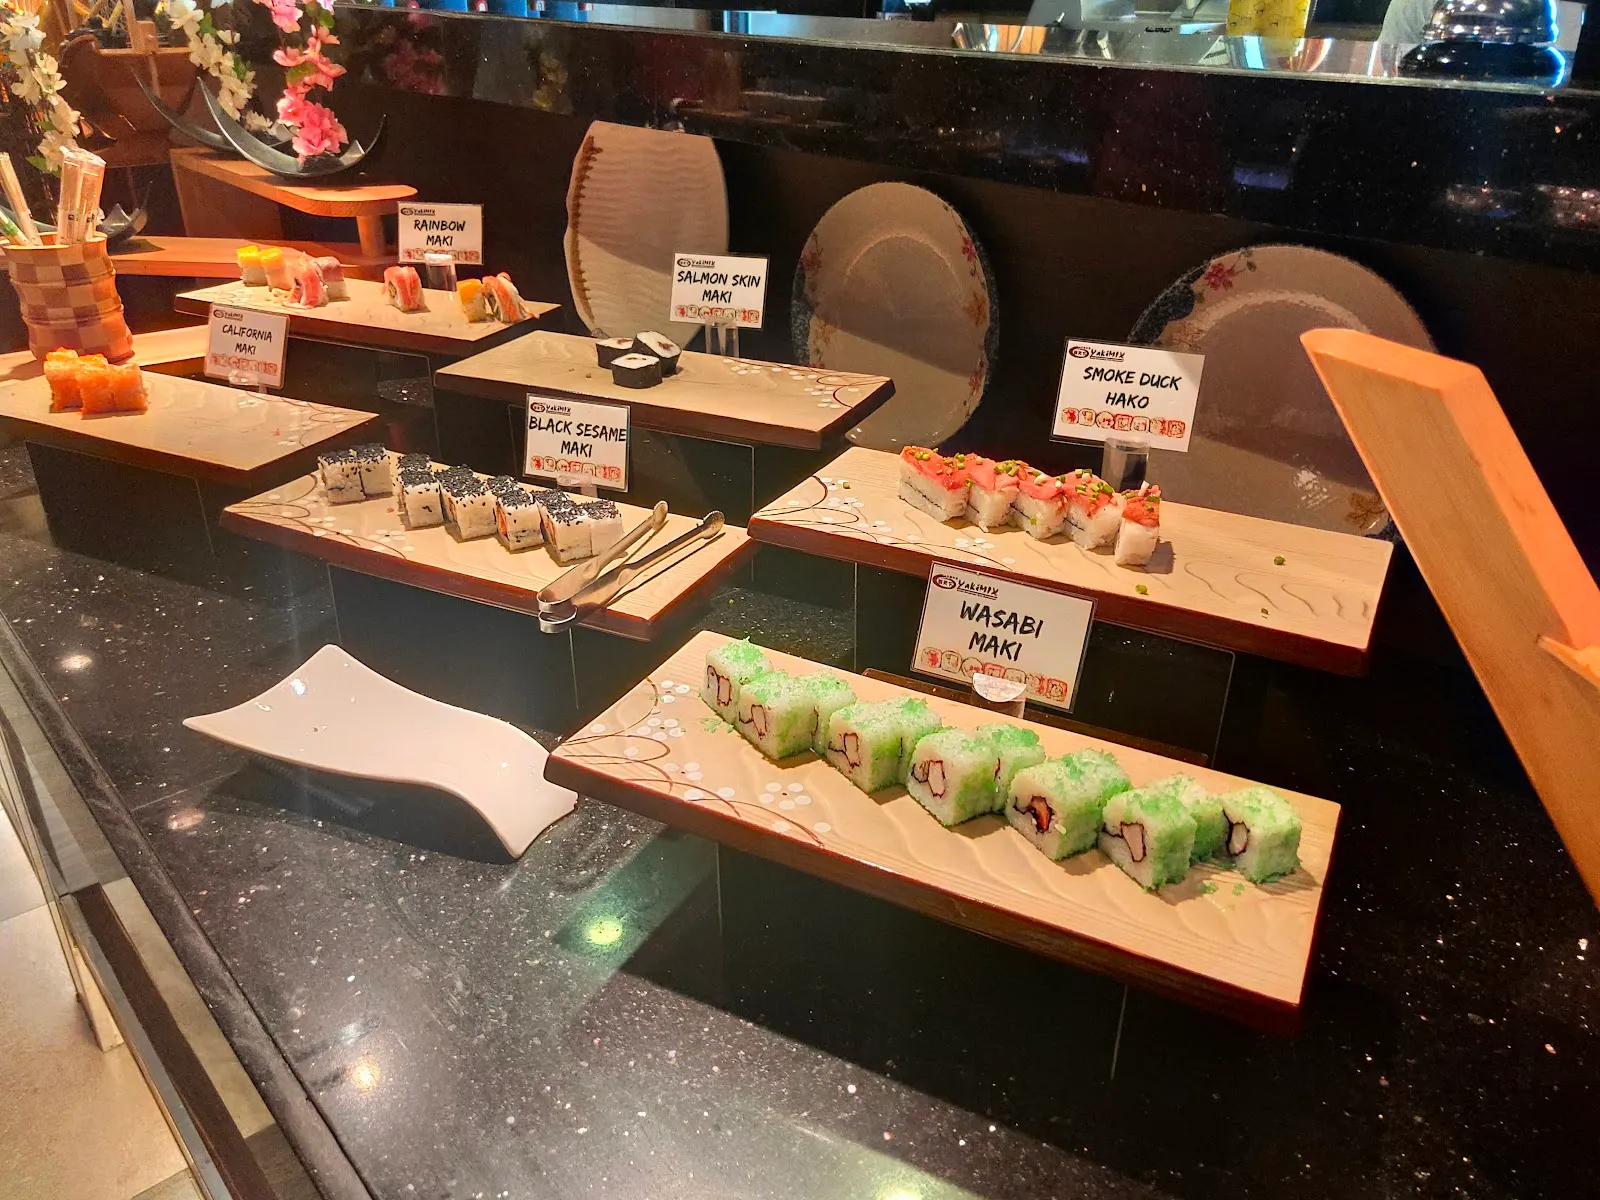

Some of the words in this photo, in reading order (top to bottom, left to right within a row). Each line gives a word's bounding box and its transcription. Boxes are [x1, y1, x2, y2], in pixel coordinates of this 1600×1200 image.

[414, 219, 466, 231] RAINBOW
[426, 235, 453, 246] MAKI
[677, 270, 728, 285] SALMON
[732, 274, 761, 288] SKIN
[702, 289, 732, 303] MAKI
[222, 324, 272, 343] CALIFORNIA
[235, 342, 256, 355] MAKI
[1083, 366, 1136, 384] SMOKE
[1139, 373, 1182, 391] DUCK
[1105, 391, 1149, 409] HAKO
[529, 415, 573, 435] BLACK
[576, 423, 627, 442] SESAME
[561, 440, 593, 458] MAKI
[960, 600, 1044, 639] WASABI
[968, 631, 1023, 662] MAKI
